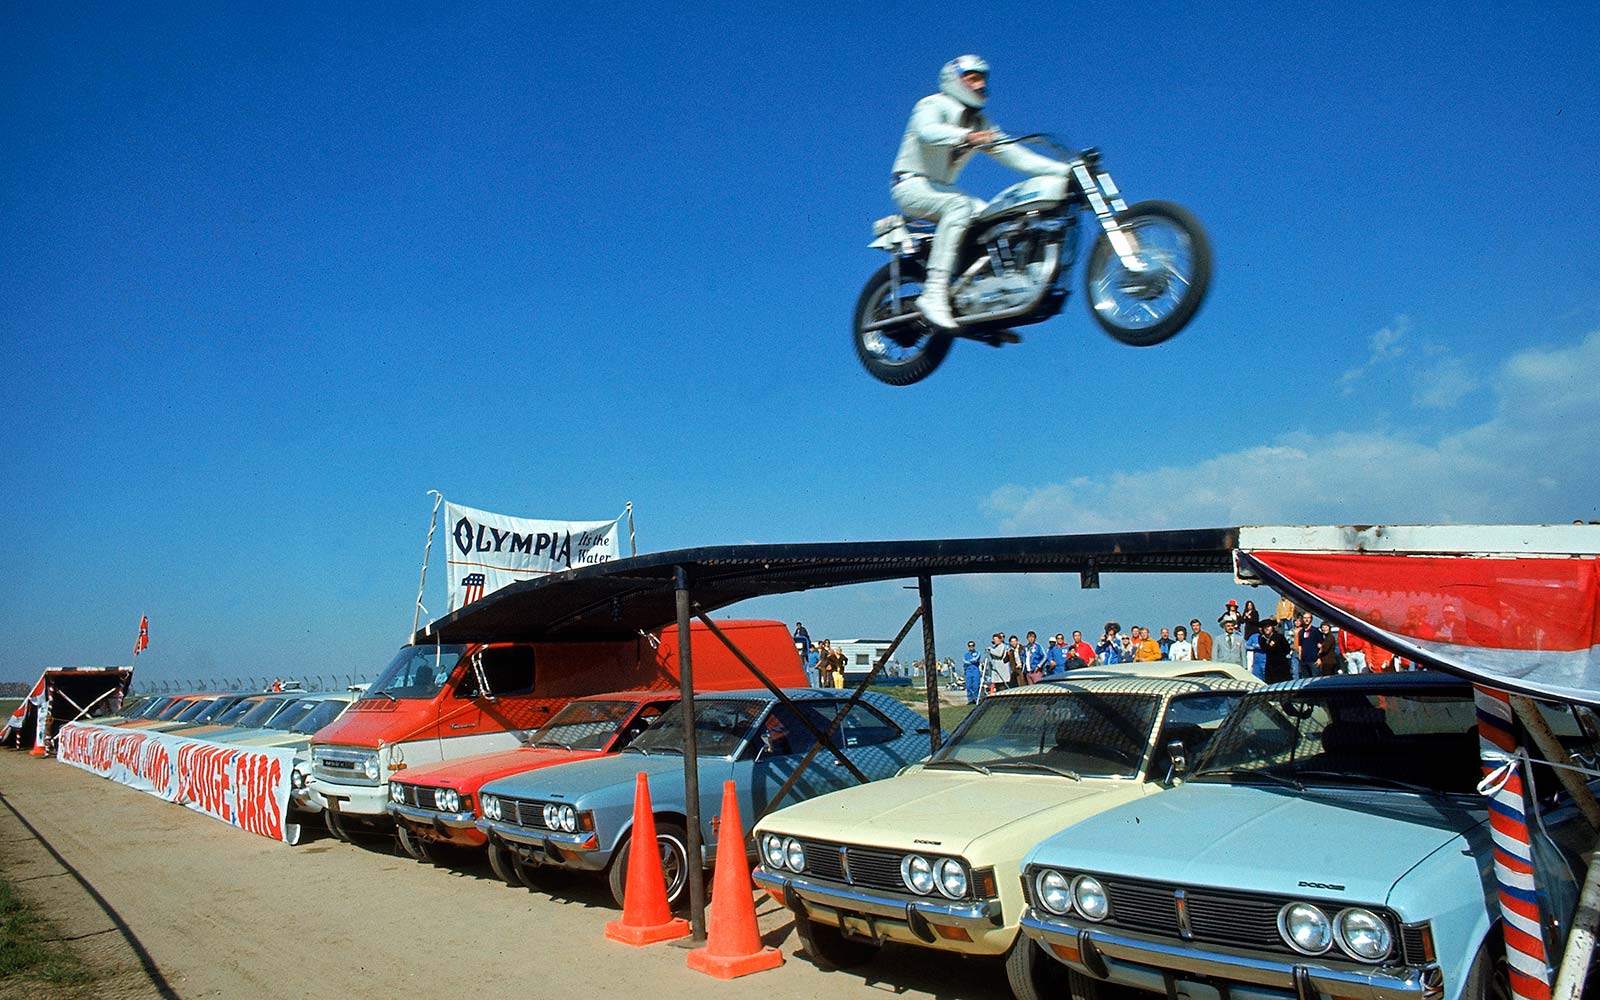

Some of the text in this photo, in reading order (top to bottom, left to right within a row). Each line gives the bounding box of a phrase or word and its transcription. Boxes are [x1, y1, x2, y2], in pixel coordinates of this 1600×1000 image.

[453, 516, 571, 568] OLYMPIA
[593, 534, 610, 546] the
[578, 549, 611, 563] Water
[235, 752, 283, 841] CARS
[1298, 881, 1345, 891] DODGE
